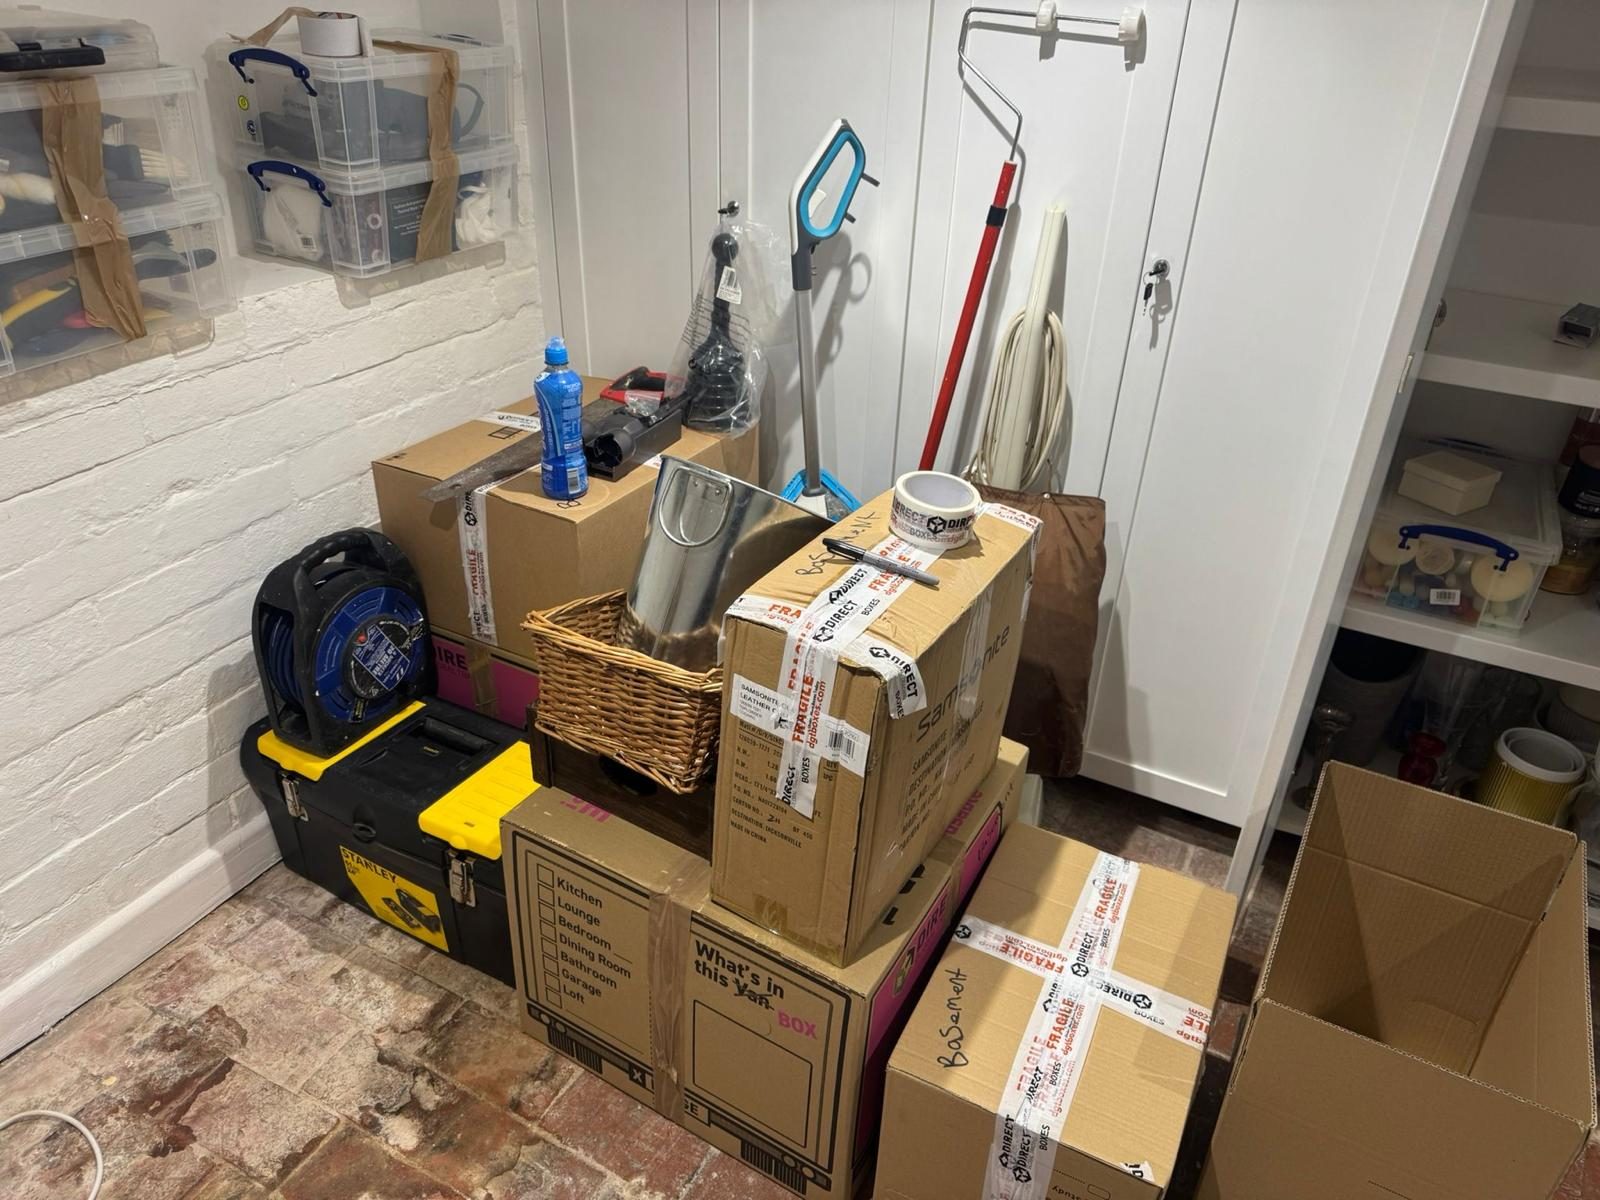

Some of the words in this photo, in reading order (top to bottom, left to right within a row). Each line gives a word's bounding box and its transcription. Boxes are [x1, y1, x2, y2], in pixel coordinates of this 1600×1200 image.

[839, 568, 868, 595] DIRECT
[825, 599, 858, 629] DIRECT
[861, 598, 880, 616] BOXES
[891, 654, 918, 698] DIRECT
[917, 625, 1010, 742] Samsonite
[740, 692, 771, 712] LEATHER
[792, 673, 814, 743] FRAGILE
[801, 757, 810, 783] BOXES
[342, 849, 396, 884] STANLEY
[557, 877, 602, 909] Kitchen
[1094, 878, 1117, 920] FRAGILE
[558, 896, 600, 926] Lounge
[559, 915, 611, 951] Bedroom
[1076, 932, 1095, 963] DIRECT
[1100, 928, 1110, 948] BOXES
[560, 933, 595, 961] Dining
[598, 953, 631, 979] Room
[561, 951, 617, 989] Bathroom
[695, 940, 760, 987] What's
[767, 976, 784, 999] in
[1000, 942, 1064, 974] FRAGILE
[562, 968, 601, 997] Garage
[695, 959, 728, 988] this
[563, 984, 584, 1004] Loft
[778, 1009, 818, 1040] BOX
[1046, 998, 1075, 1050] FRAGILE
[1134, 1009, 1165, 1025] BOXES
[1049, 1062, 1062, 1086] BOXES
[1001, 1114, 1015, 1153] DIRECT
[1039, 1124, 1051, 1151] BOXES
[1017, 1132, 1032, 1168] DIRECT
